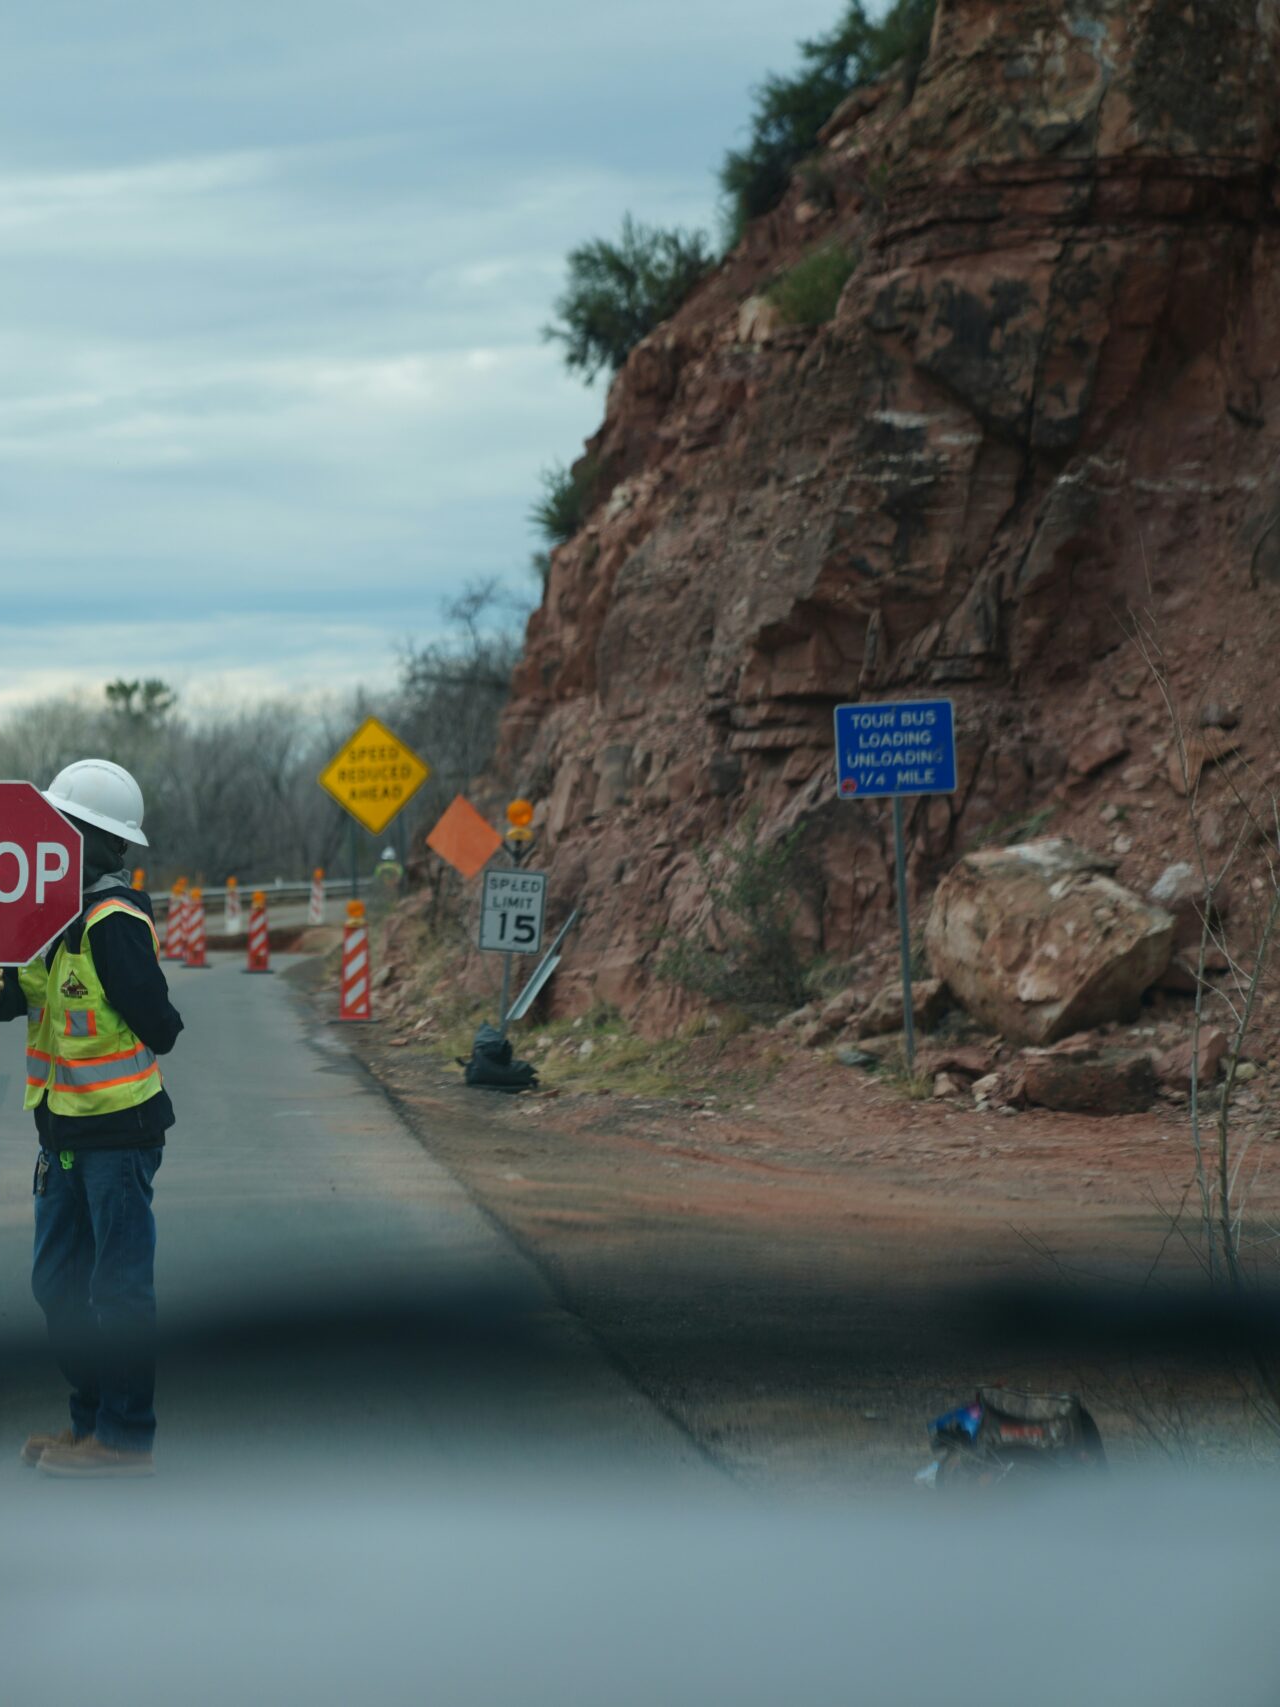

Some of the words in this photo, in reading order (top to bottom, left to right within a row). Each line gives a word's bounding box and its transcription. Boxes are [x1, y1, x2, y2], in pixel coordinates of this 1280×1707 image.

[851, 712, 895, 729] TOUR
[901, 710, 936, 727] BUS
[859, 730, 932, 749] LOADING
[348, 745, 399, 764] SPEED
[847, 750, 943, 768] UNLOADING
[337, 763, 412, 784] REDUCED
[860, 771, 886, 786] 1/4
[897, 768, 935, 785] MILE
[349, 785, 403, 801] AHEAD
[489, 877, 541, 893] SPEED
[492, 896, 533, 910] LIMIT
[499, 912, 536, 944] 15
